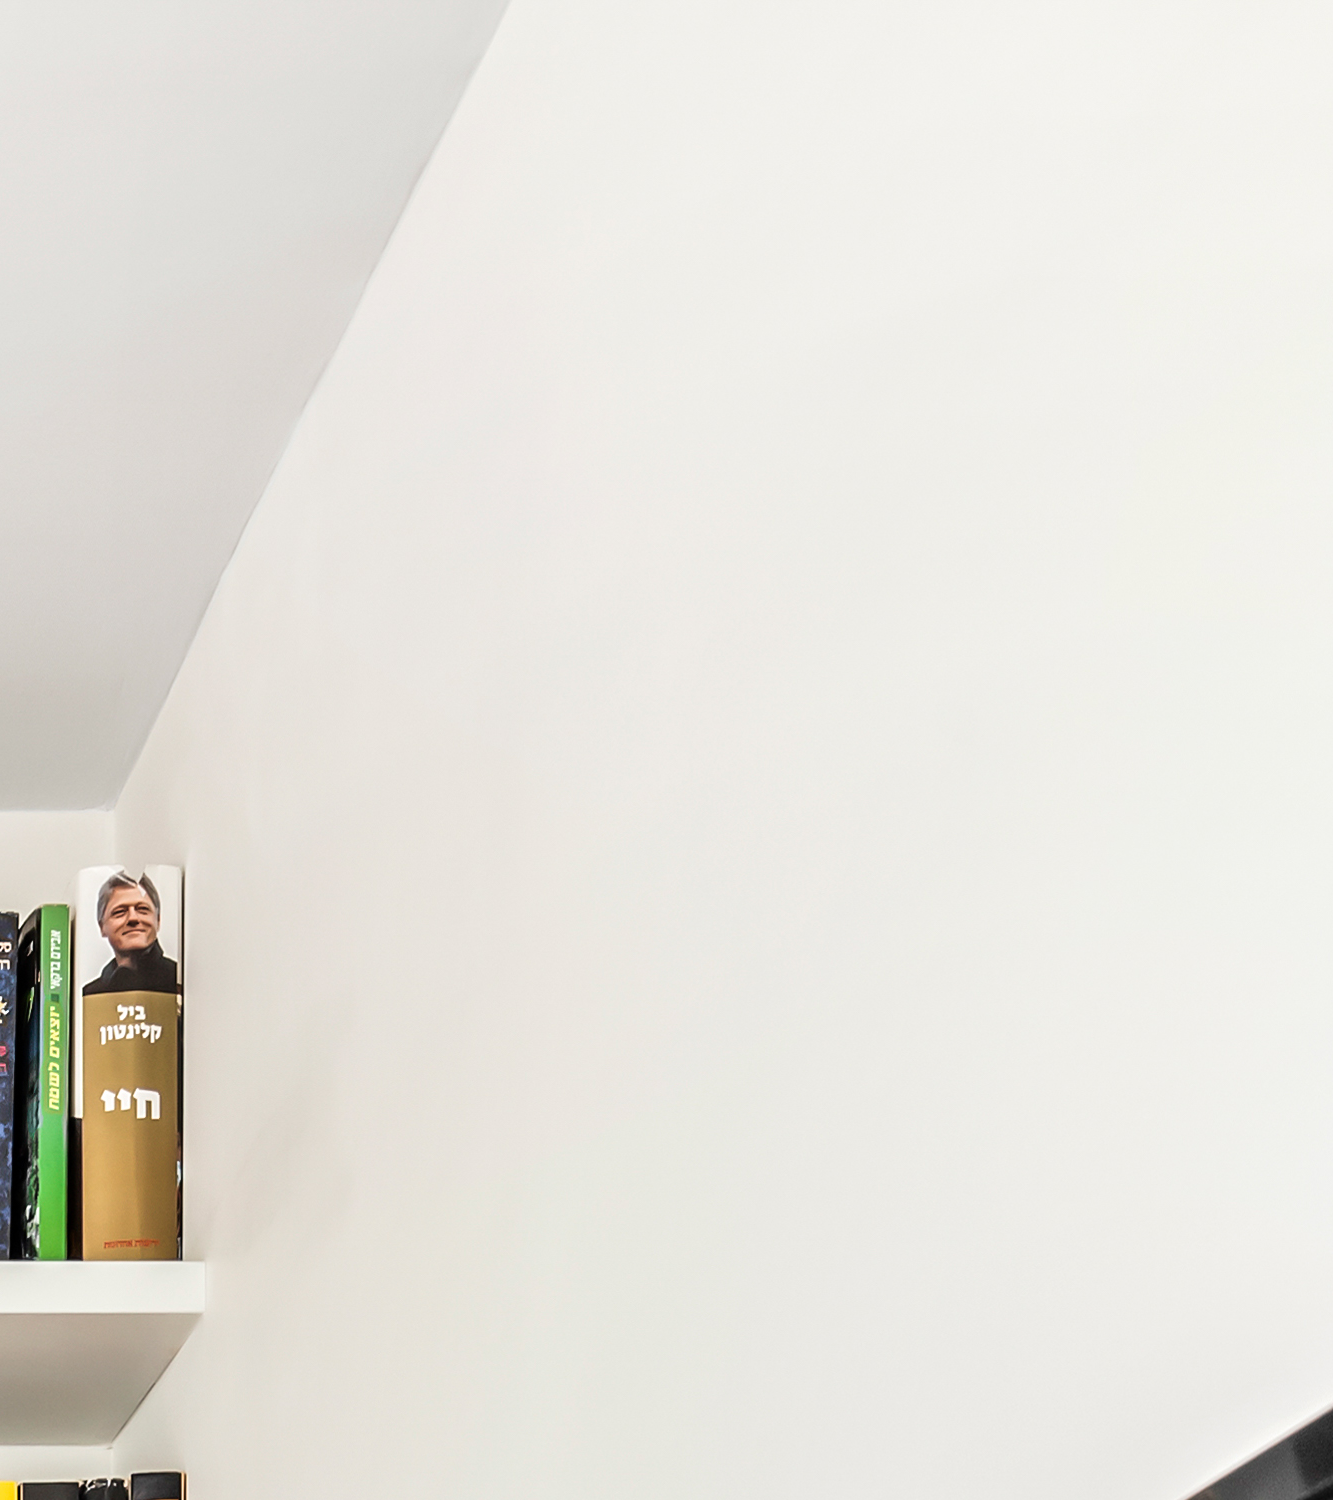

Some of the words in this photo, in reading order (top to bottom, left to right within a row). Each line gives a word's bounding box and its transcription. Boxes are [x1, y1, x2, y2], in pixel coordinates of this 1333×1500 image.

[117, 1004, 145, 1020] ביל
[100, 1022, 162, 1045] קלינטון
[101, 1088, 161, 1119] חיי
